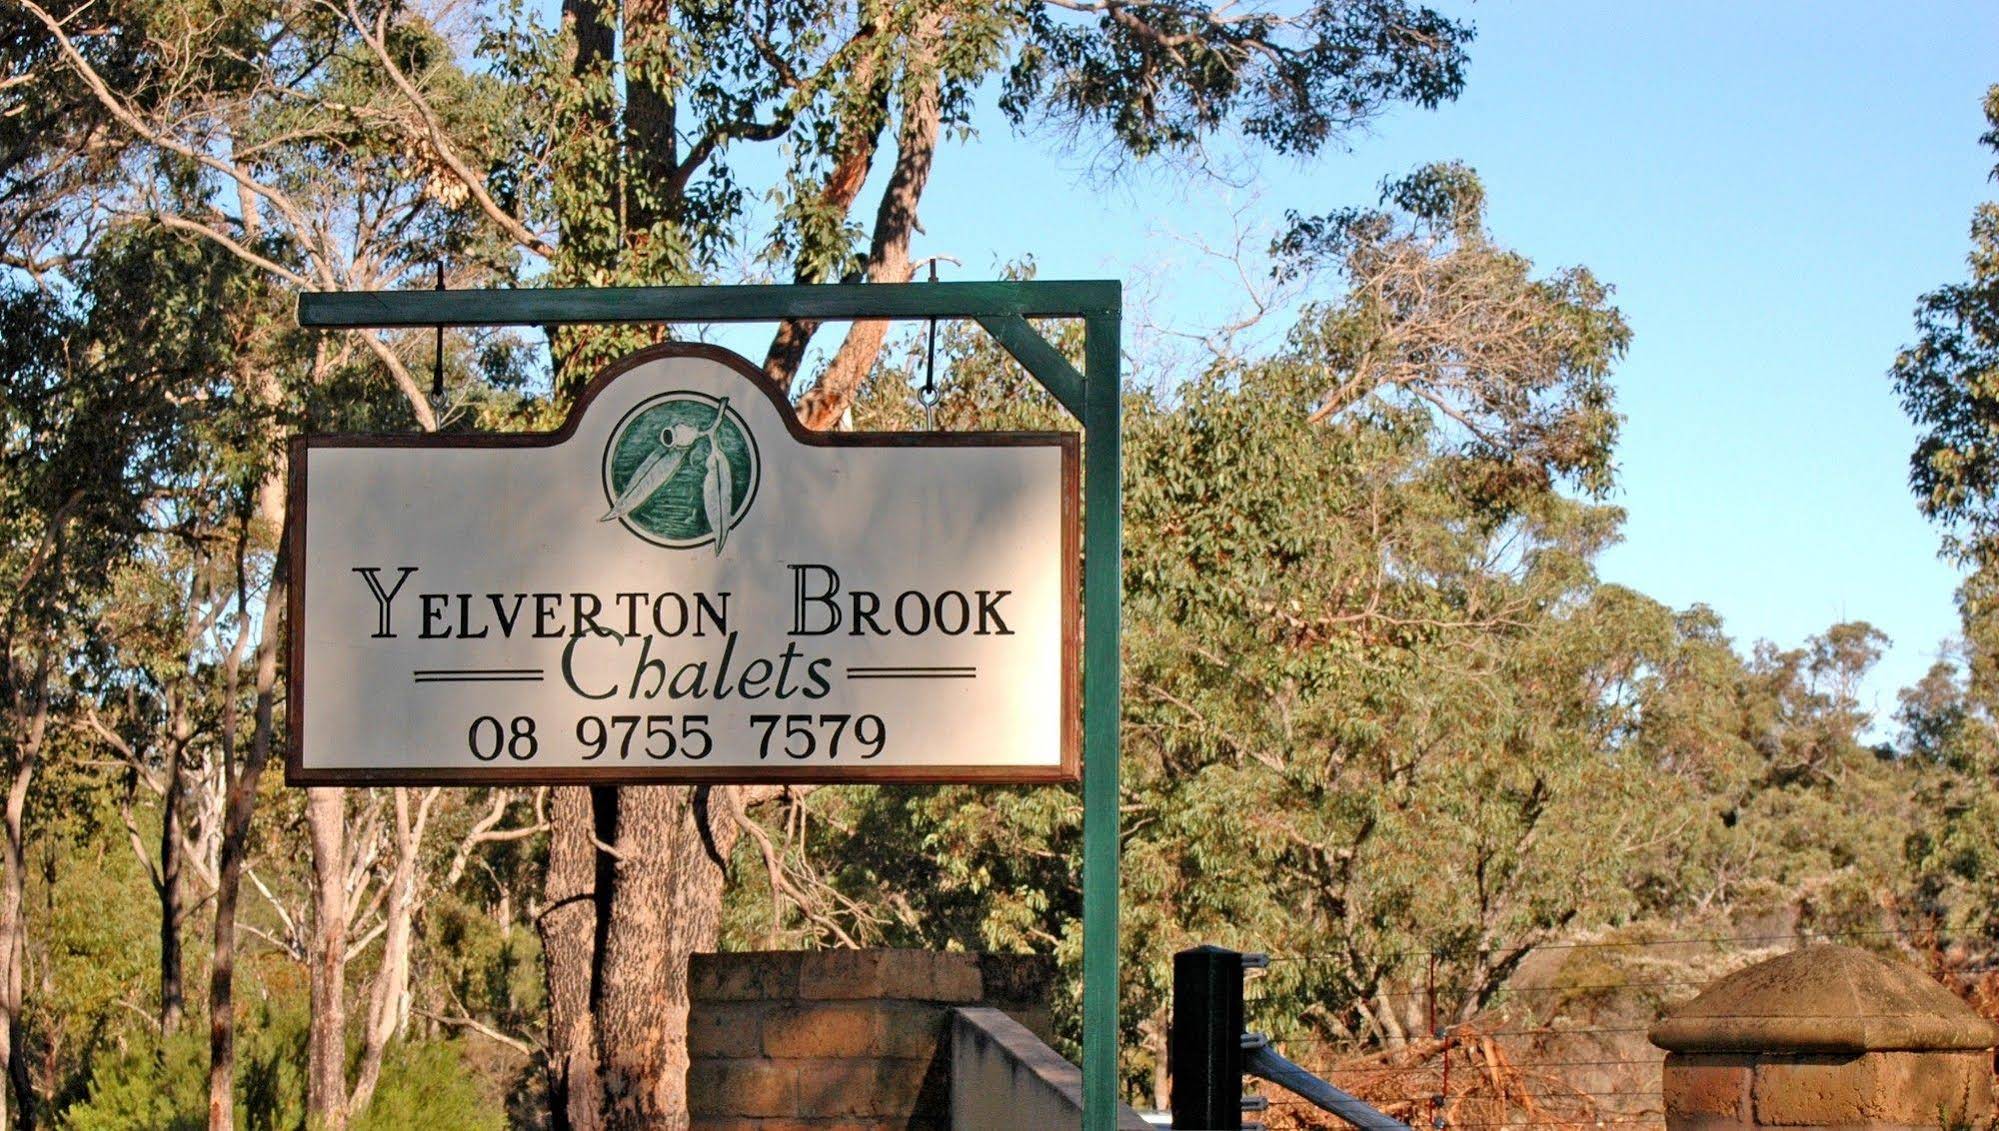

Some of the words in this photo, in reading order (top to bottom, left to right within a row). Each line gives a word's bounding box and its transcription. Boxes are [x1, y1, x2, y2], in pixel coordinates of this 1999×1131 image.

[352, 567, 731, 639] YELVERTON
[787, 564, 1015, 636] BROOK
[561, 626, 832, 700] Chalets
[468, 716, 538, 761] 08
[576, 715, 713, 760] 9755
[750, 714, 886, 760] 7579
